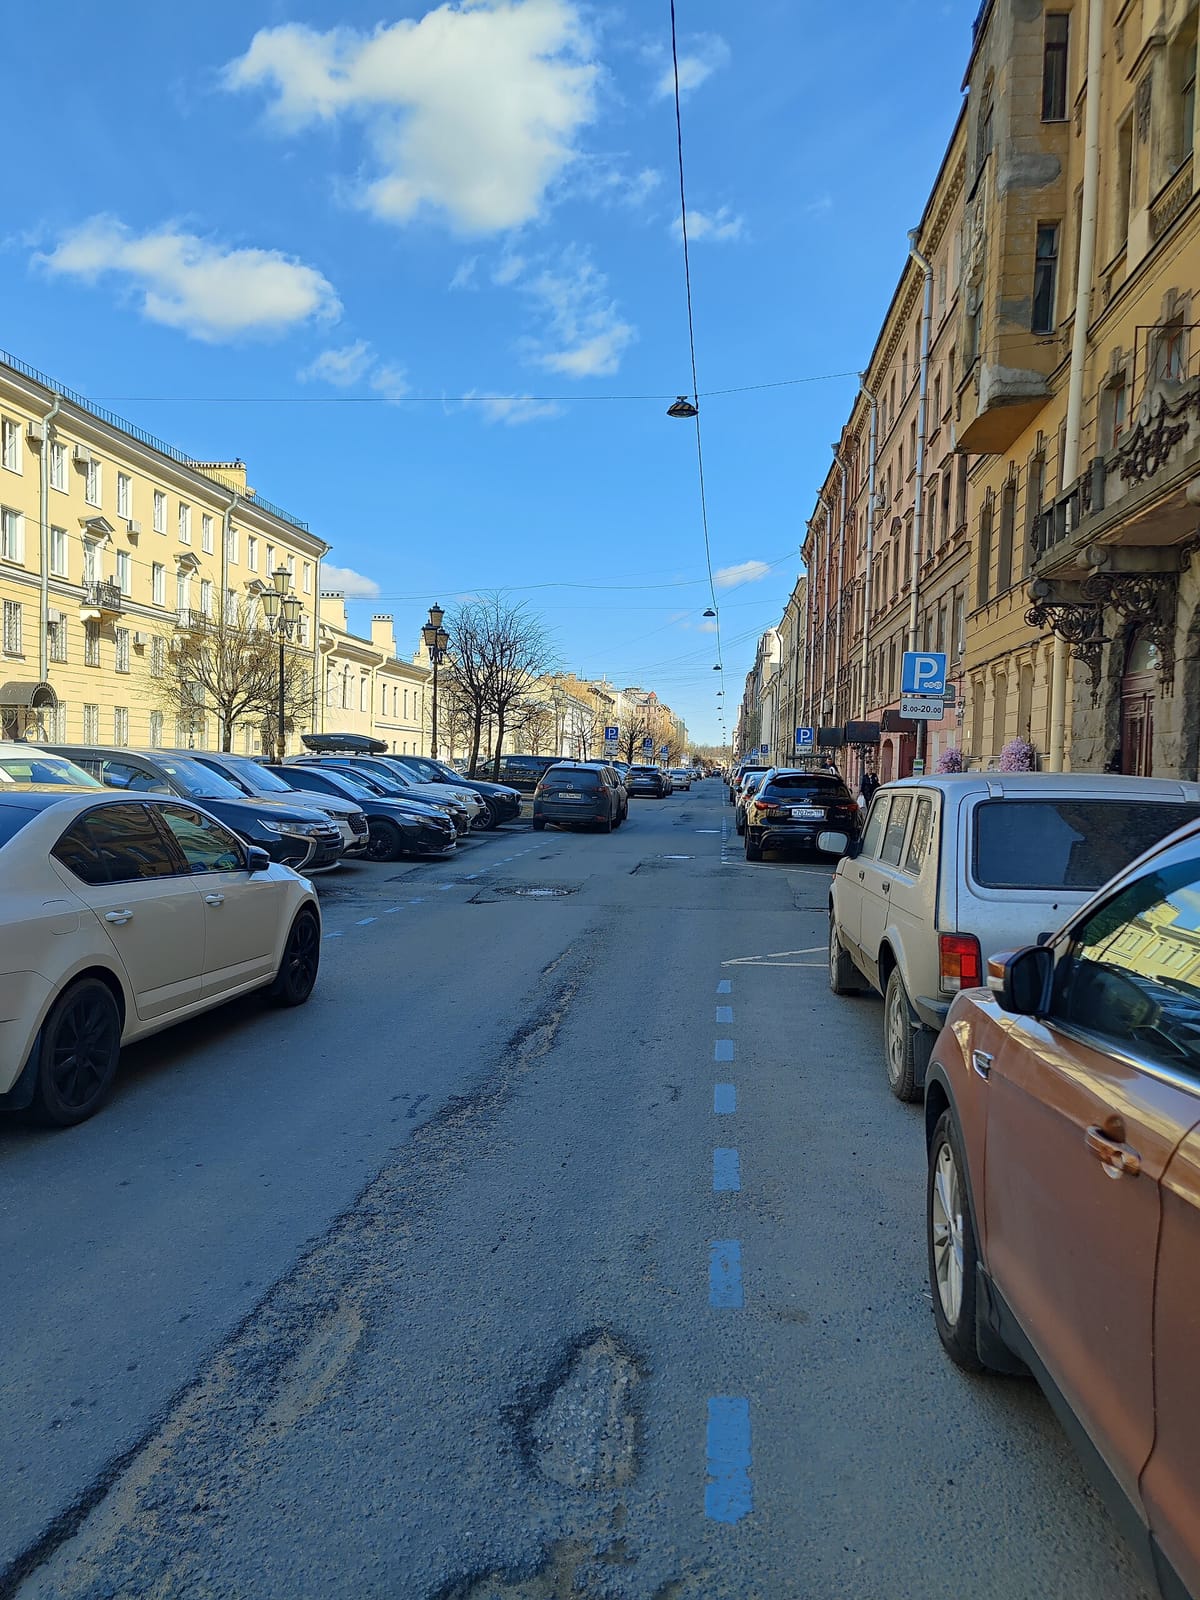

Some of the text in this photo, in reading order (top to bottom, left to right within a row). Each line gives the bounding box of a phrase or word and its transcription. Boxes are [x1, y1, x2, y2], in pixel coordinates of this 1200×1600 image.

[914, 657, 938, 690] P
[902, 704, 942, 714] 8.00-20.00
[800, 729, 810, 743] P
